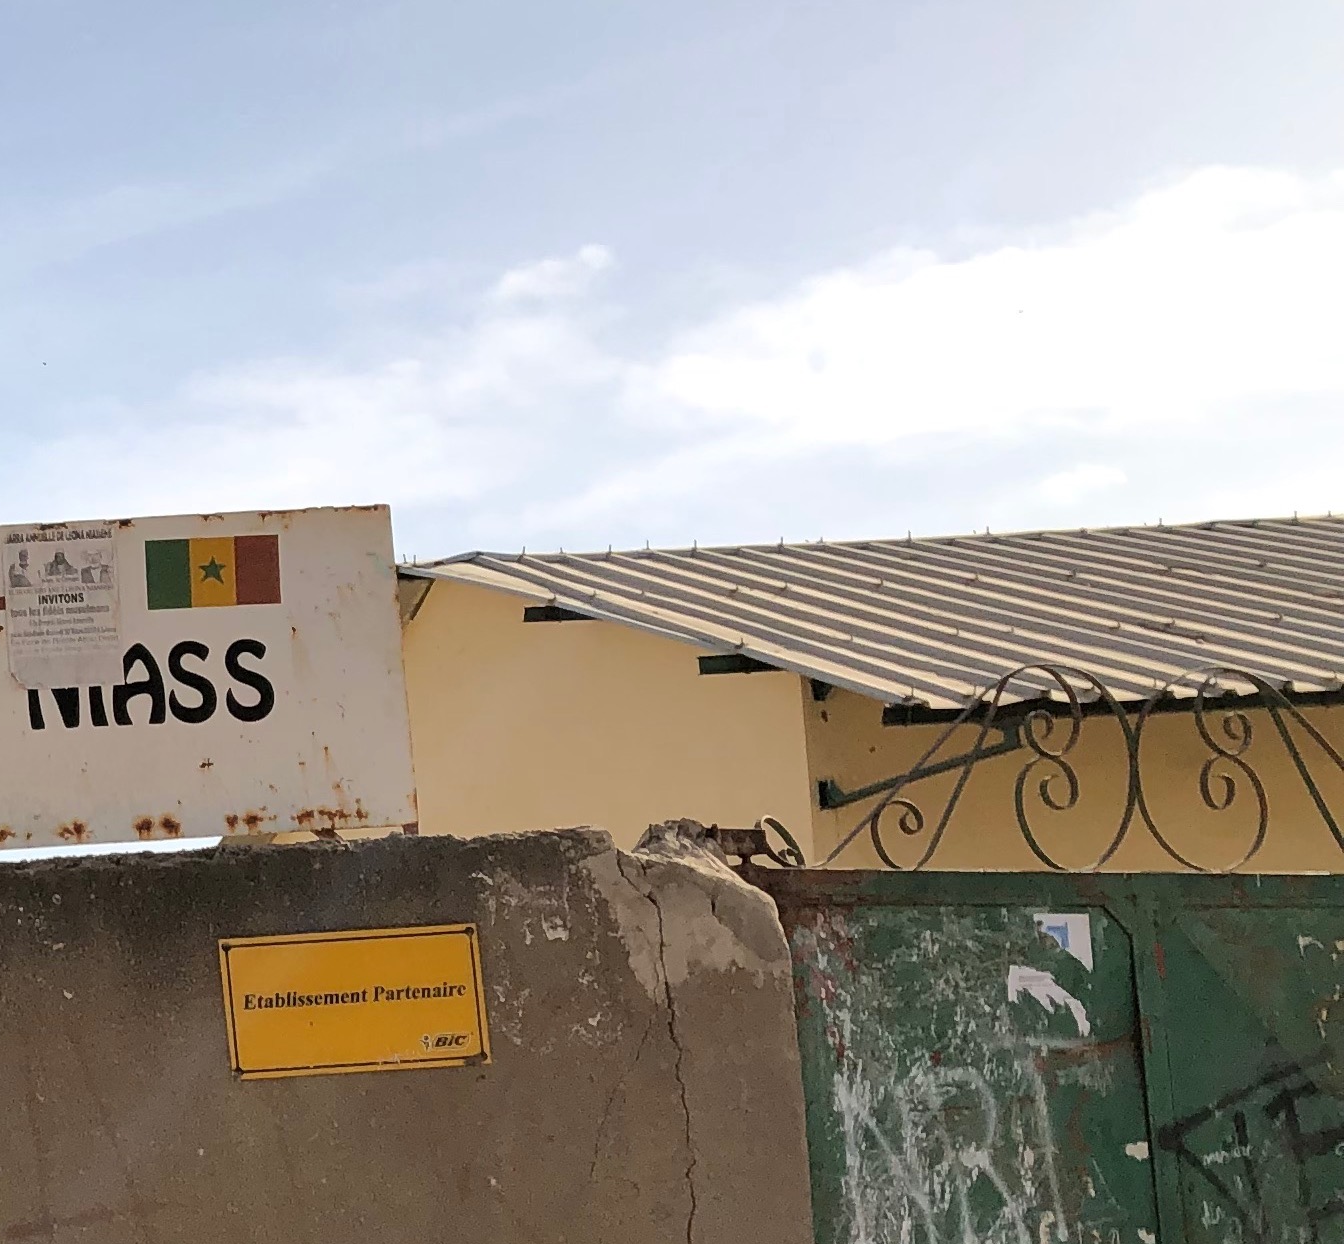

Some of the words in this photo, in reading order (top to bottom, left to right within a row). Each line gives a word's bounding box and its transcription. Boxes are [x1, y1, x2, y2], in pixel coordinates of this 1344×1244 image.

[38, 592, 85, 605] INVITONS
[243, 989, 367, 1011] Etablissement
[373, 982, 466, 1002] Partenaire
[434, 1035, 468, 1047] BIC
